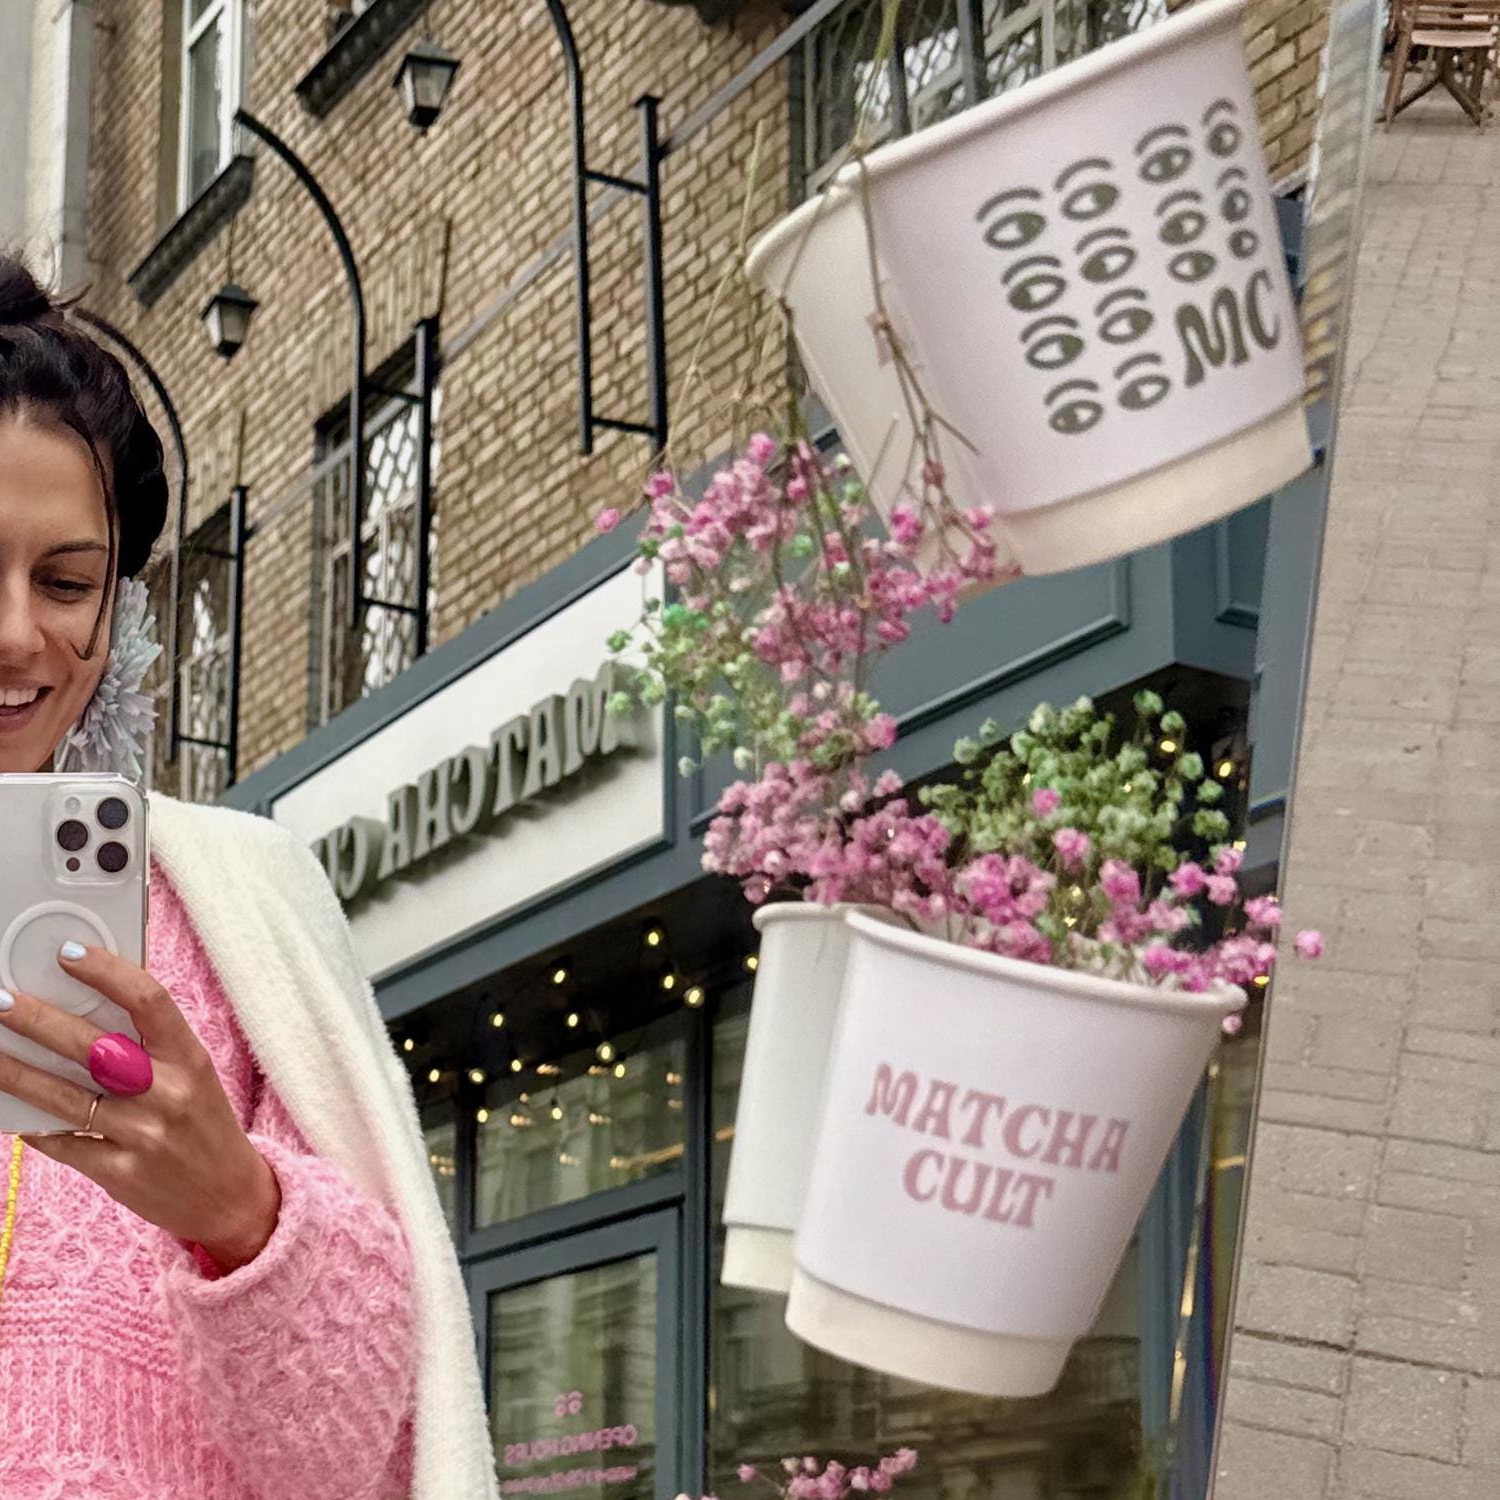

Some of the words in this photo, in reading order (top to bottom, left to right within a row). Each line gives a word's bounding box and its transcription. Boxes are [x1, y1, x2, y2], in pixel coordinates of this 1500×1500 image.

[1175, 268, 1281, 389] MC
[864, 1061, 1131, 1174] MATCHA
[902, 1148, 1056, 1229] CULT
